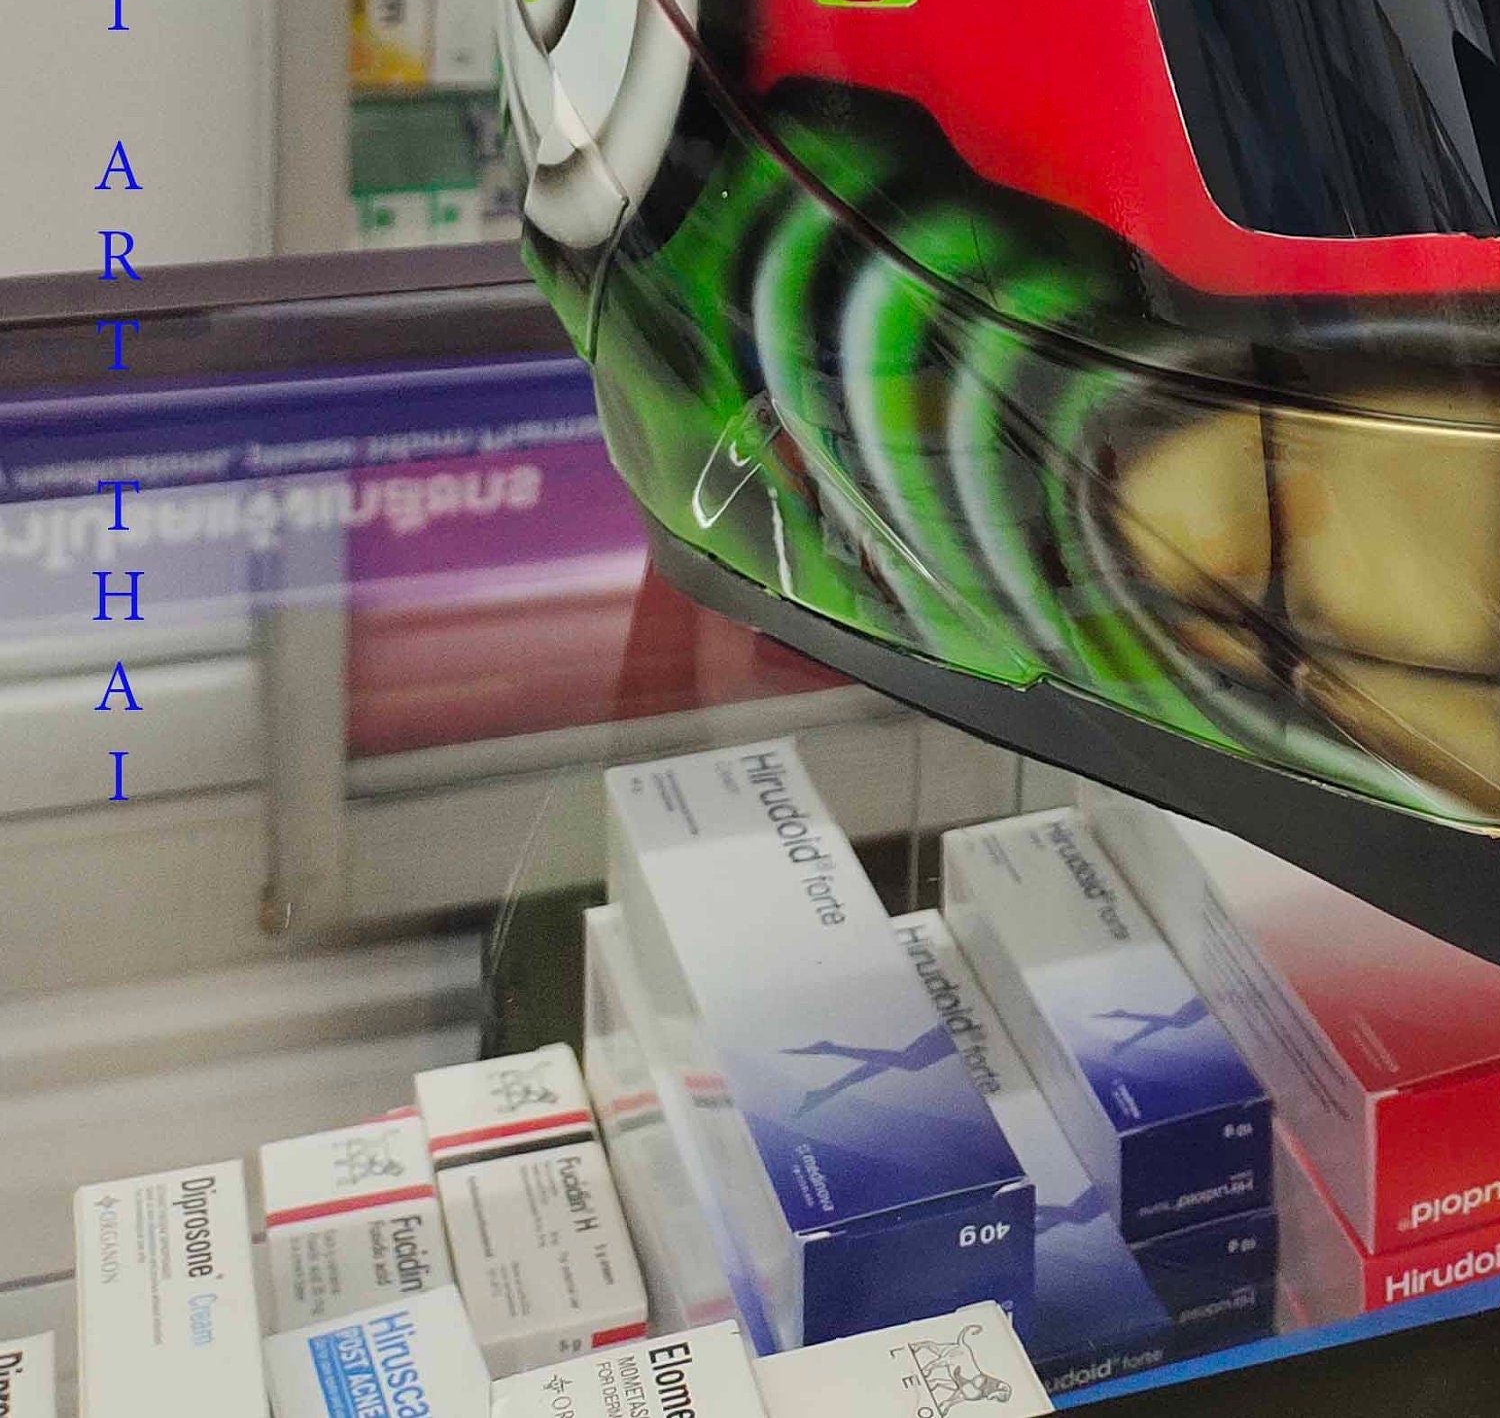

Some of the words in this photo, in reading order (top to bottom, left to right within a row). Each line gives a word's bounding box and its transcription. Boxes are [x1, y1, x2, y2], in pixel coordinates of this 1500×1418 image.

[740, 751, 819, 862] Hirudoid
[802, 869, 845, 926] forte
[173, 1175, 217, 1279] Diprosone
[390, 1215, 423, 1293] Fucidin
[959, 1224, 977, 1248] g
[979, 1222, 1011, 1245] 40
